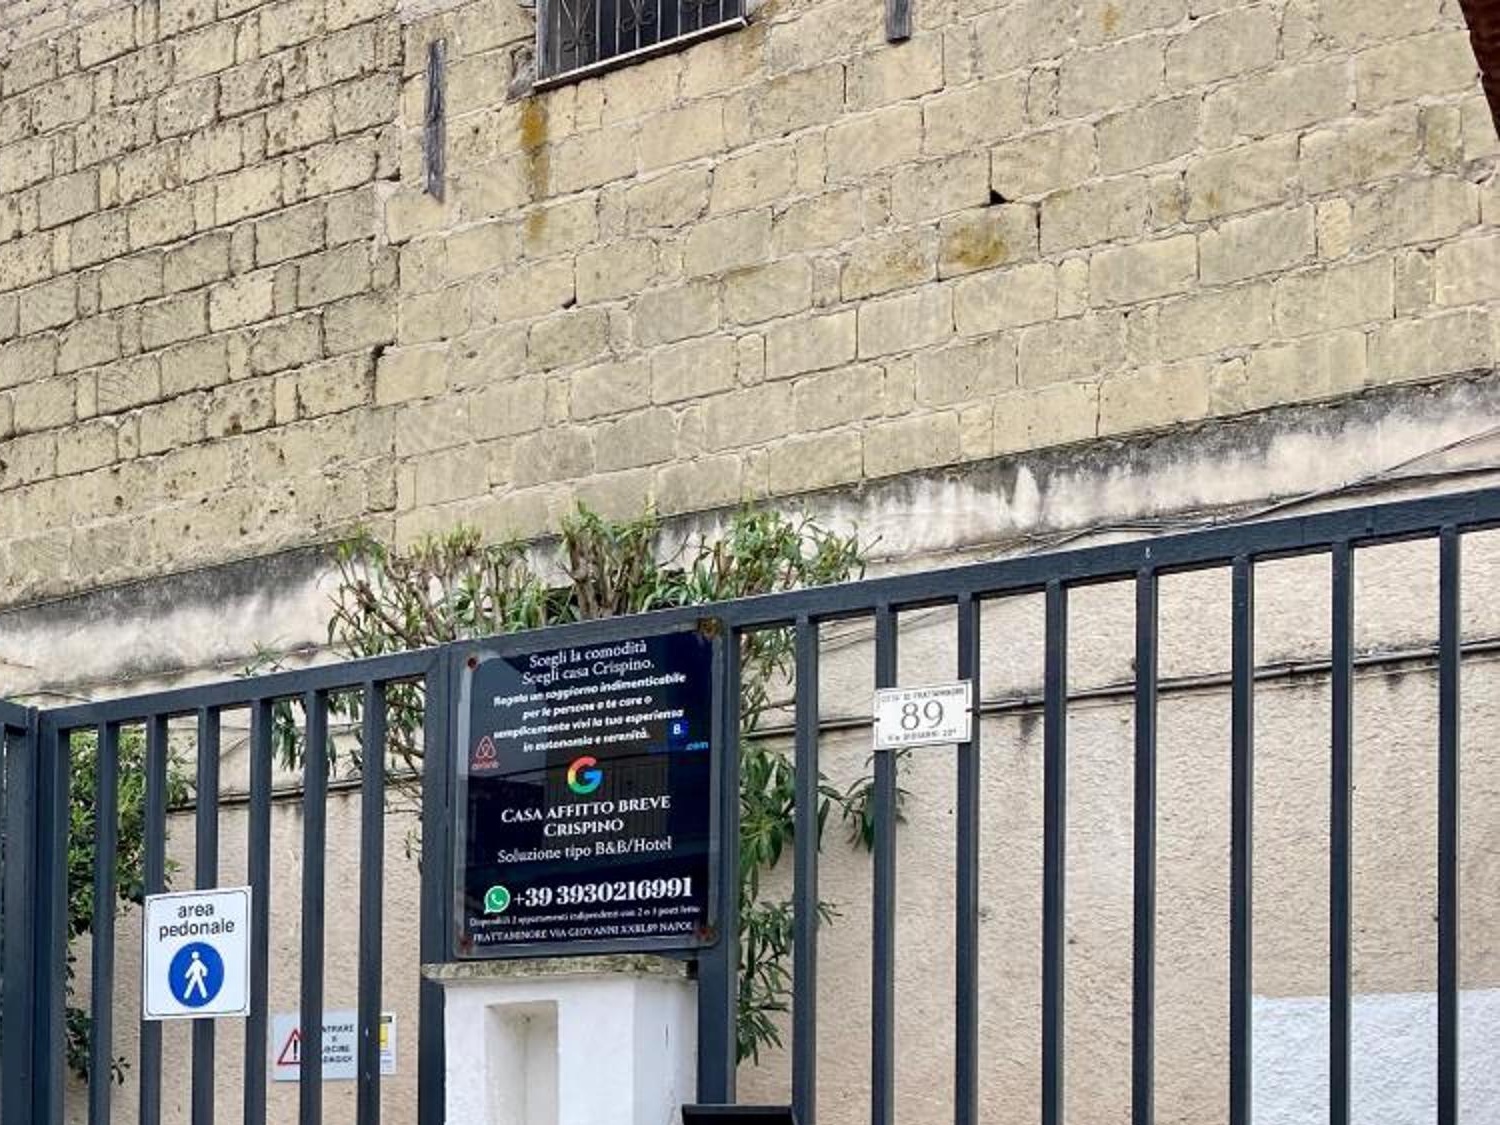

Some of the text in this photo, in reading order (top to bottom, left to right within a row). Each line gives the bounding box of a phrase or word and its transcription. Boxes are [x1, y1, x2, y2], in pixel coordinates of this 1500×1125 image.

[529, 639, 647, 669] Scegli la comodità
[522, 657, 655, 687] Scegli casa Crispino.
[600, 672, 687, 693] indimenticabile
[900, 699, 944, 731] 89
[500, 795, 672, 824] CASA AFFITTO BREVE
[543, 818, 624, 838] CRISPINO
[497, 835, 673, 864] Soluzione tipo B&B/Hotel
[513, 876, 693, 908] +39 3930216991
[177, 903, 215, 919] area
[159, 917, 235, 942] pedonale
[549, 928, 567, 938] VIA
[567, 924, 620, 938] GIOVANNI
